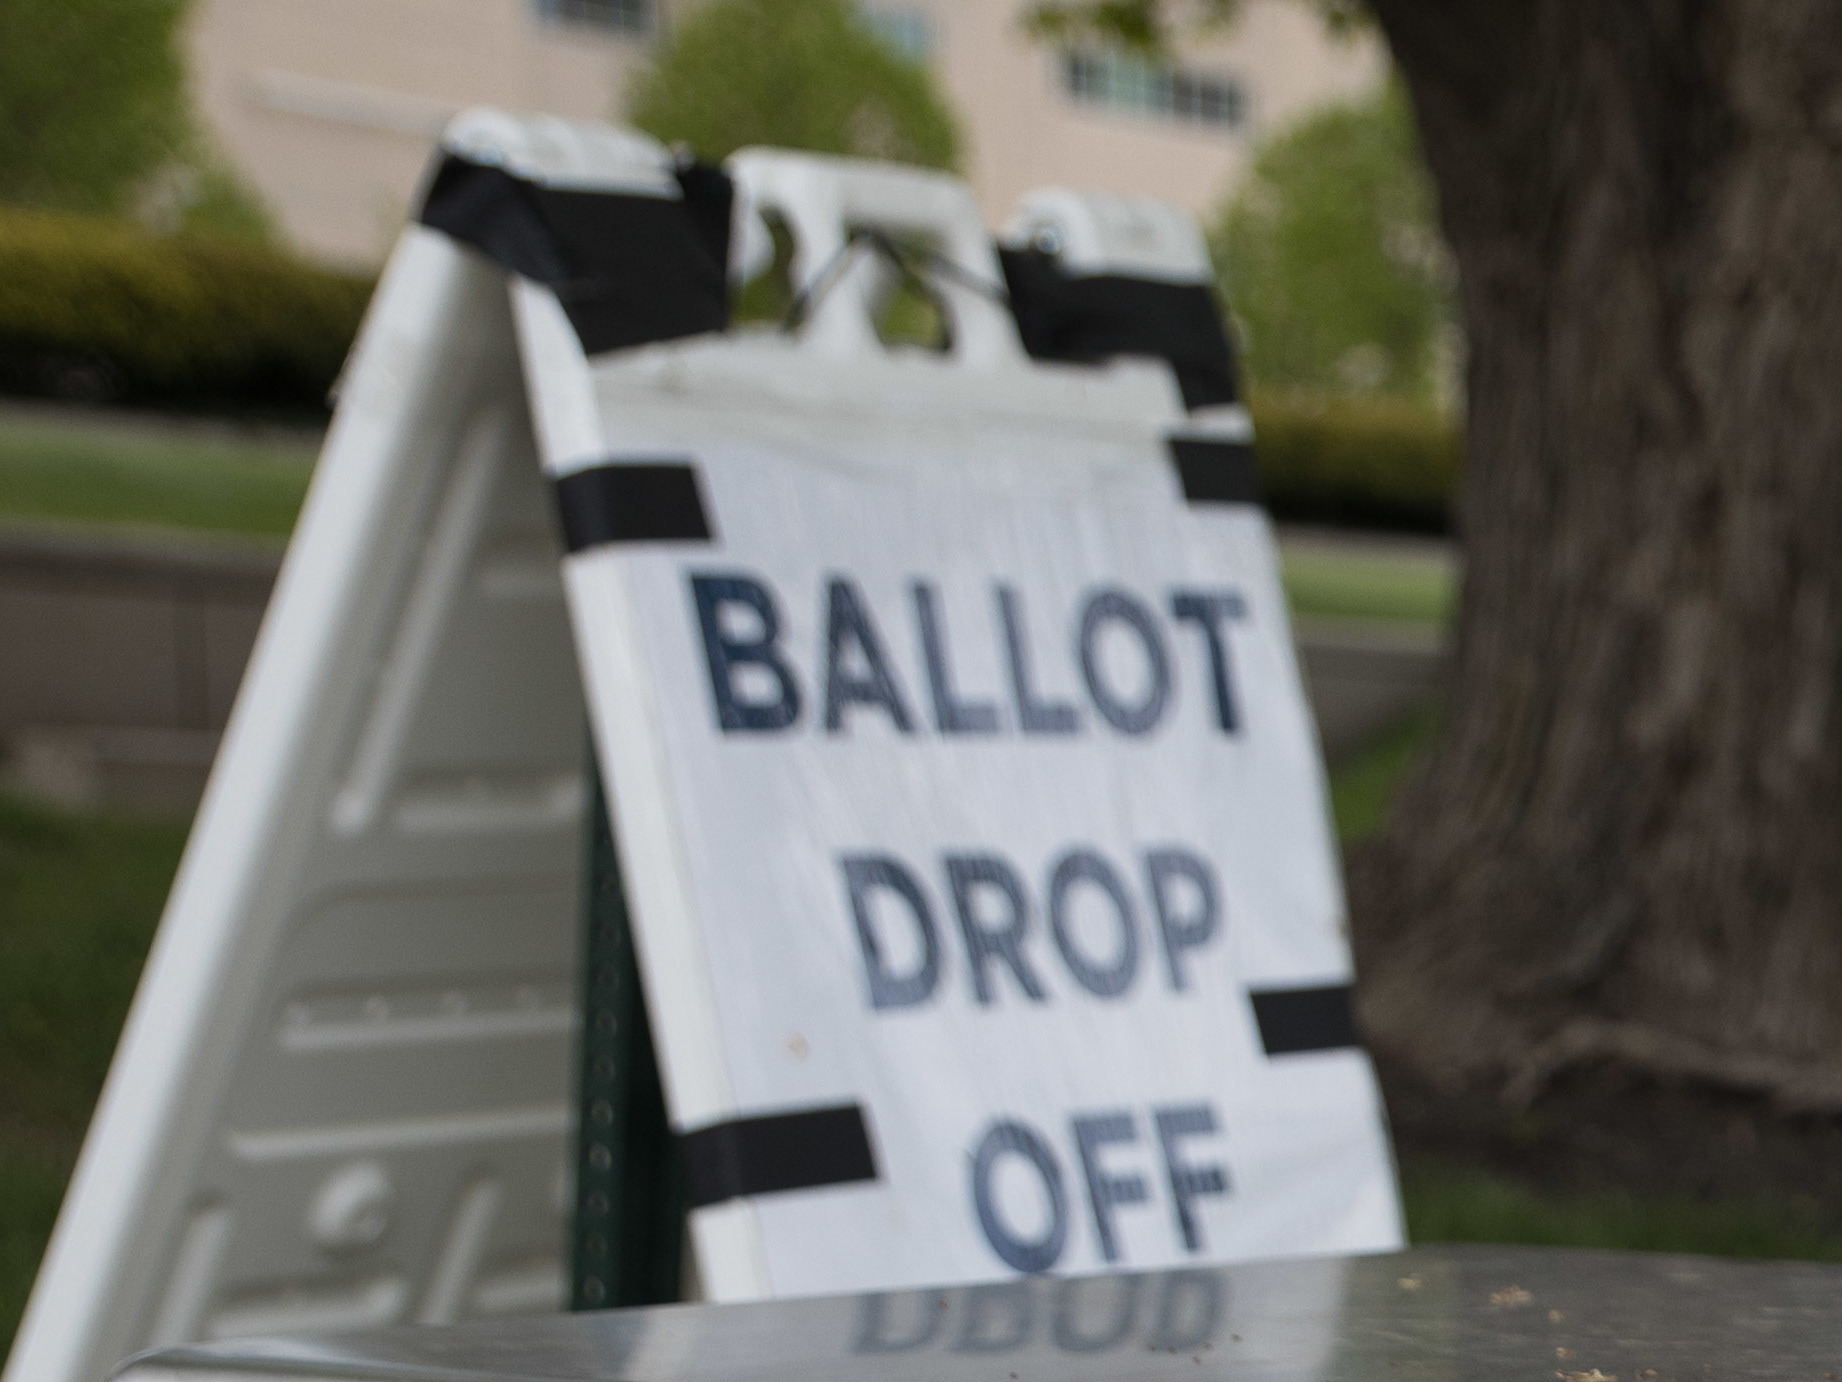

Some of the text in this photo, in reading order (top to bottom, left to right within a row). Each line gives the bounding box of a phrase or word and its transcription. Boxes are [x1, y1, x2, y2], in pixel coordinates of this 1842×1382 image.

[685, 569, 1248, 737] BALLOT
[837, 847, 1220, 1012] DROP
[967, 1105, 1232, 1274] OFF
